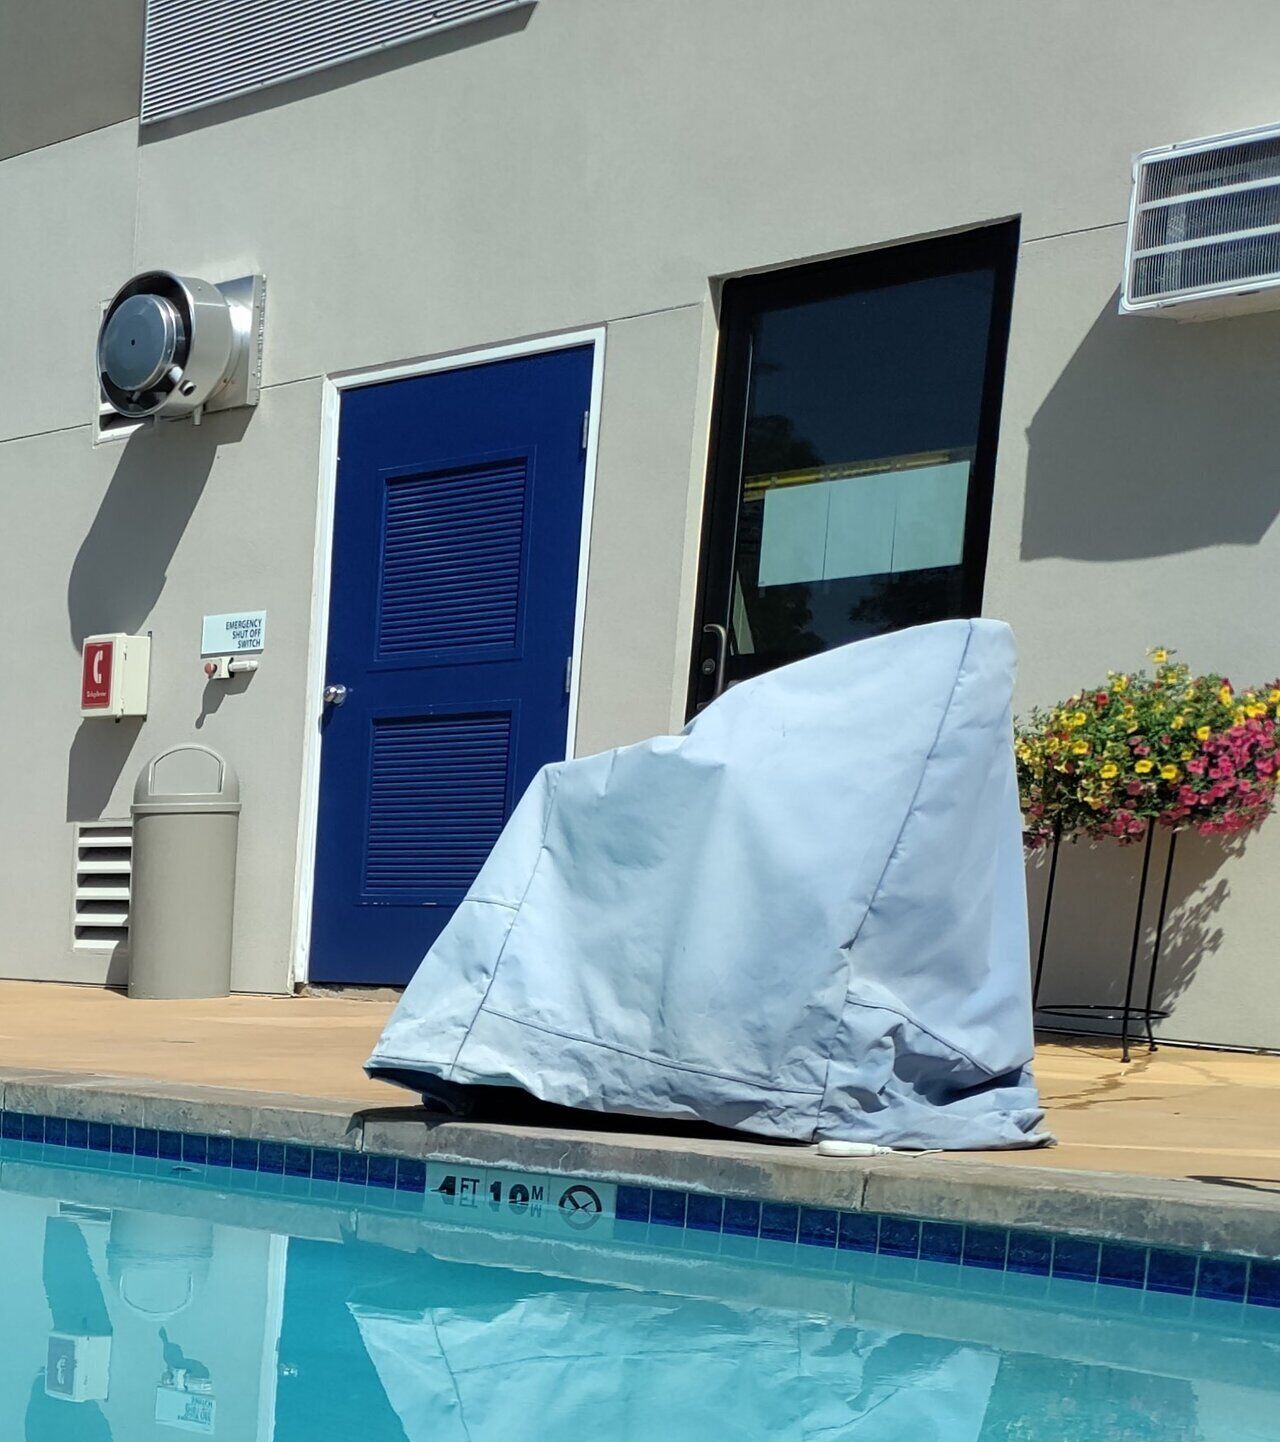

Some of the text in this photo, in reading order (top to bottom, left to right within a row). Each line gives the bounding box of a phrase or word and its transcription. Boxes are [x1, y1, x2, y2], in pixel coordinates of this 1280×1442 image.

[225, 618, 262, 630] EMERGENCY
[232, 628, 261, 640] SHUT OFF
[237, 639, 261, 649] SWITCH
[460, 1176, 480, 1195] FT
[531, 1185, 544, 1201] M
